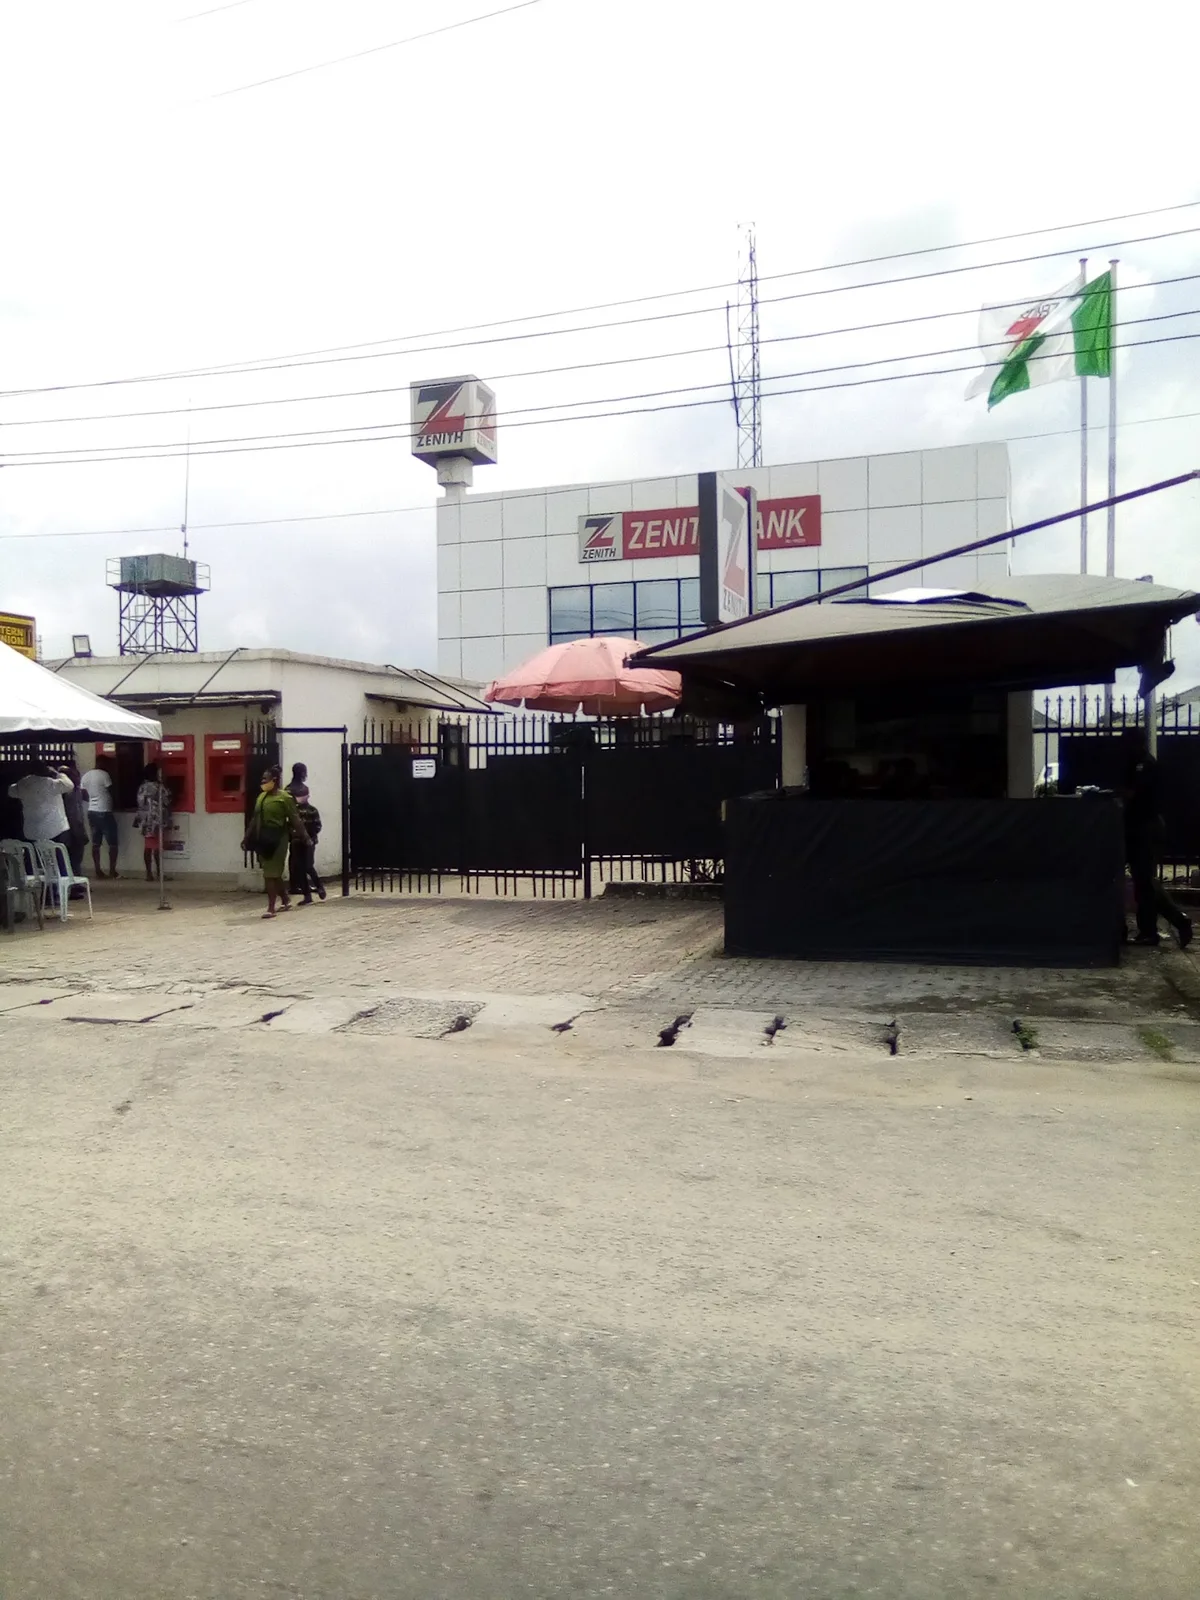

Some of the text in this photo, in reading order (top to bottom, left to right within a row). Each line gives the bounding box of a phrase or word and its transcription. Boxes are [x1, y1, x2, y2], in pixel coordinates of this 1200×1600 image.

[416, 431, 464, 447] ZENITH
[628, 508, 807, 549] ZENIT ANK
[582, 548, 617, 559] ZENITH
[0, 626, 24, 637] TERN
[0, 634, 24, 645] NION
